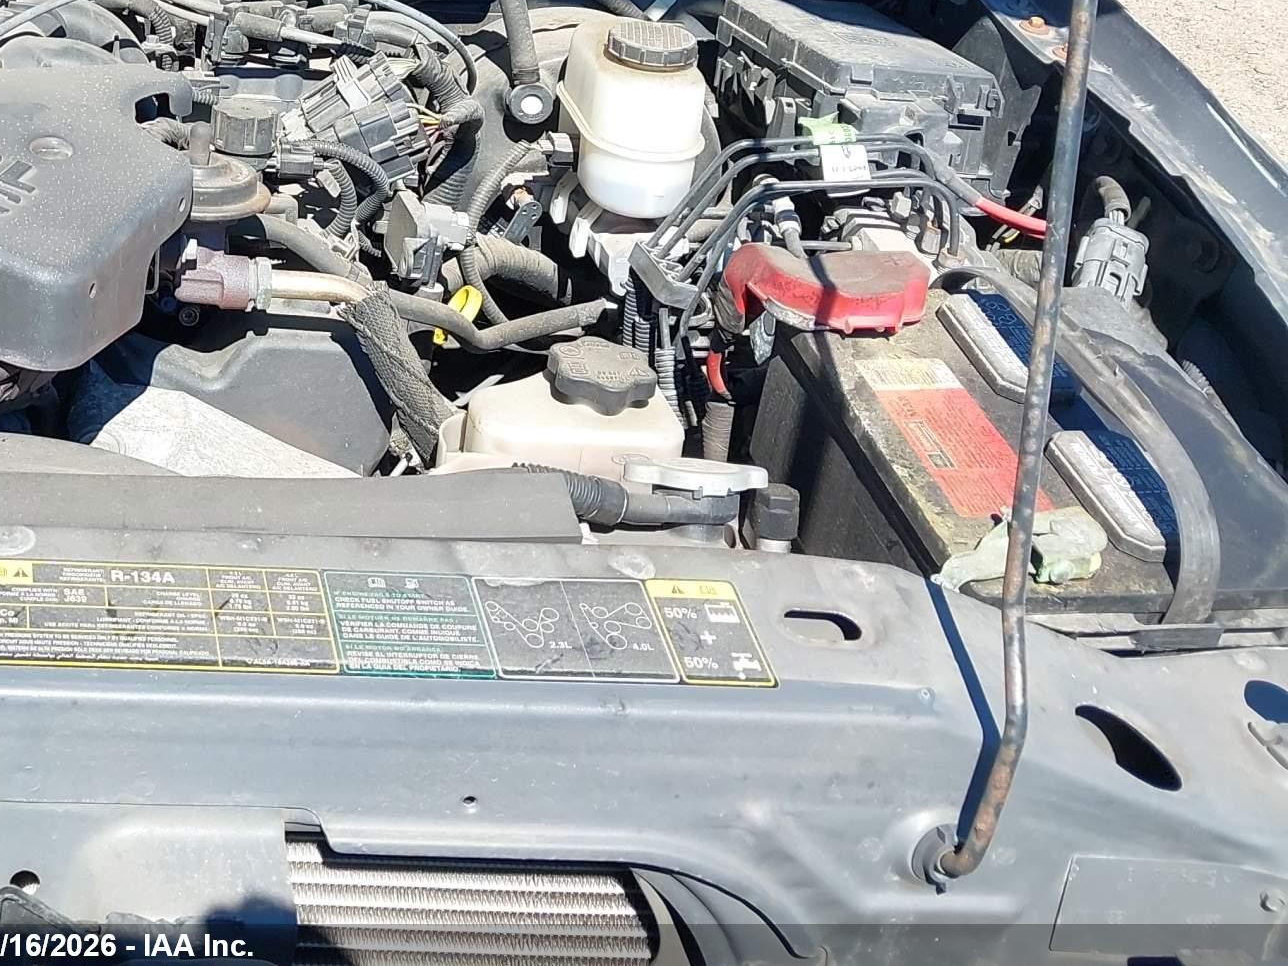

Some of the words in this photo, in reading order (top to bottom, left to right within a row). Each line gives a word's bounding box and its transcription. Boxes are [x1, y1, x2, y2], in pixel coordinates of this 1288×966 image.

[110, 569, 176, 584] R-134A
[64, 588, 85, 596] SAE
[64, 595, 88, 603] J639
[664, 607, 697, 619] 50%
[549, 641, 573, 649] 2.3L
[632, 642, 655, 650] 4.0L
[684, 656, 719, 669] 50%
